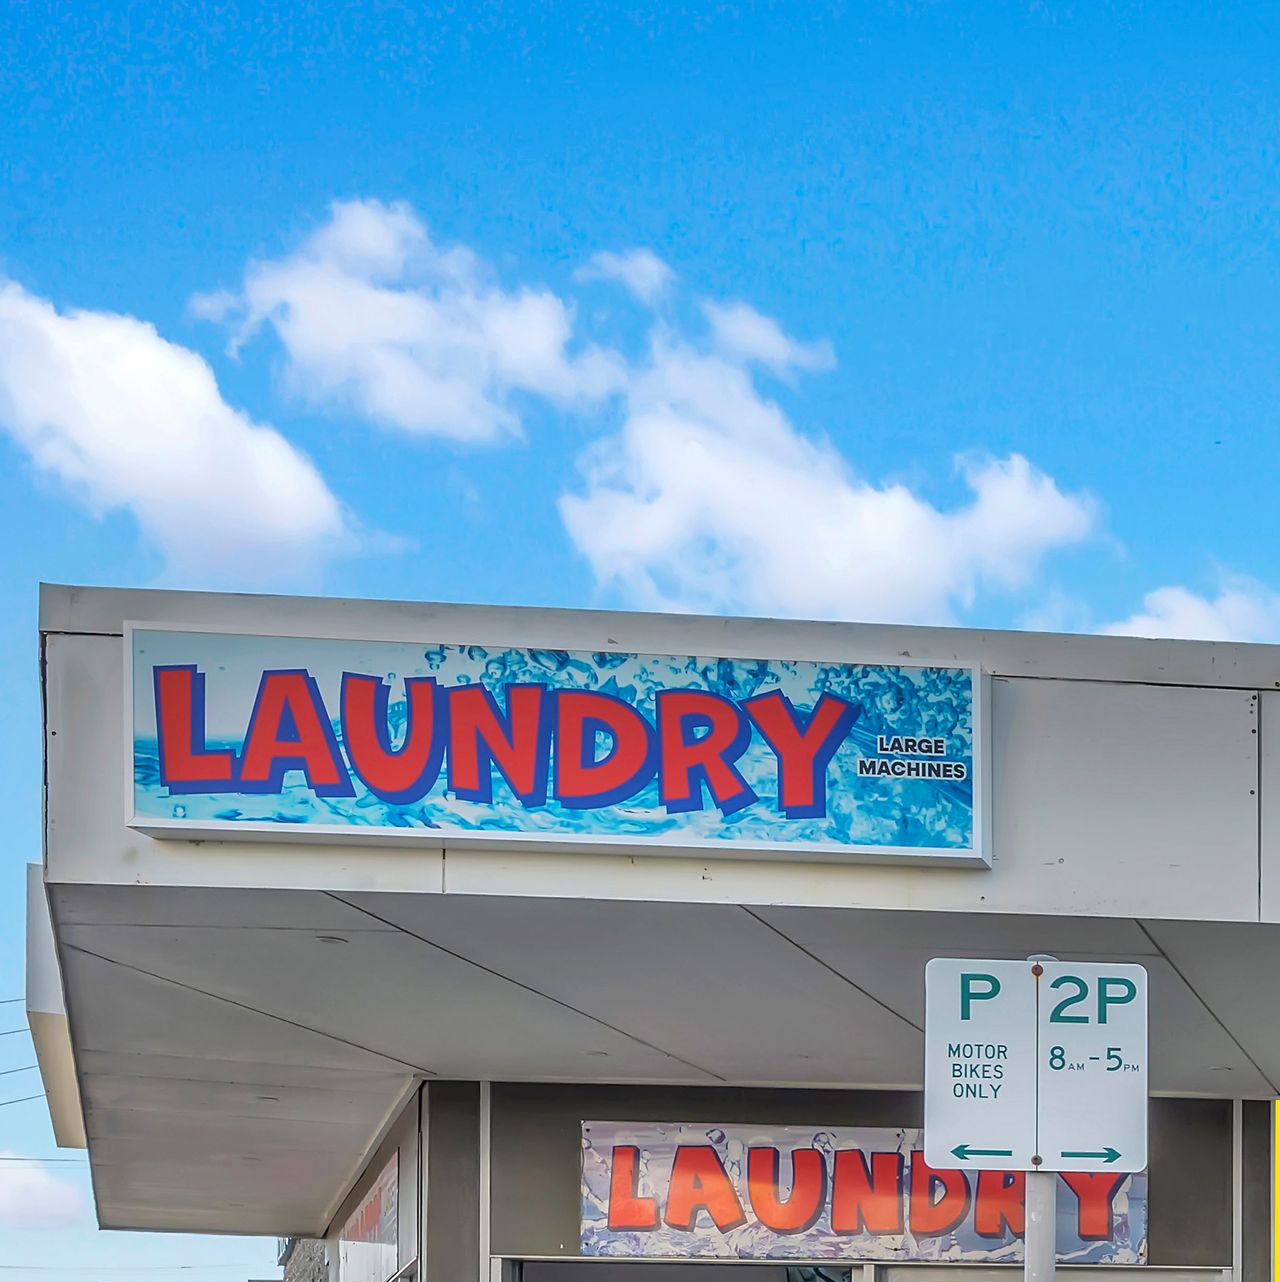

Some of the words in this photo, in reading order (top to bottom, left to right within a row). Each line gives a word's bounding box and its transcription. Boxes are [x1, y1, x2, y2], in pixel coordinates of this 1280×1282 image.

[153, 664, 861, 818] LAUNDRY
[877, 734, 945, 756] LARGE
[858, 758, 966, 782] MACHINES
[960, 973, 1001, 1021] P
[1049, 975, 1137, 1025] 2P
[948, 1043, 1008, 1060] MOTOR
[952, 1063, 1004, 1079] BIKES
[953, 1083, 1002, 1099] ONLY
